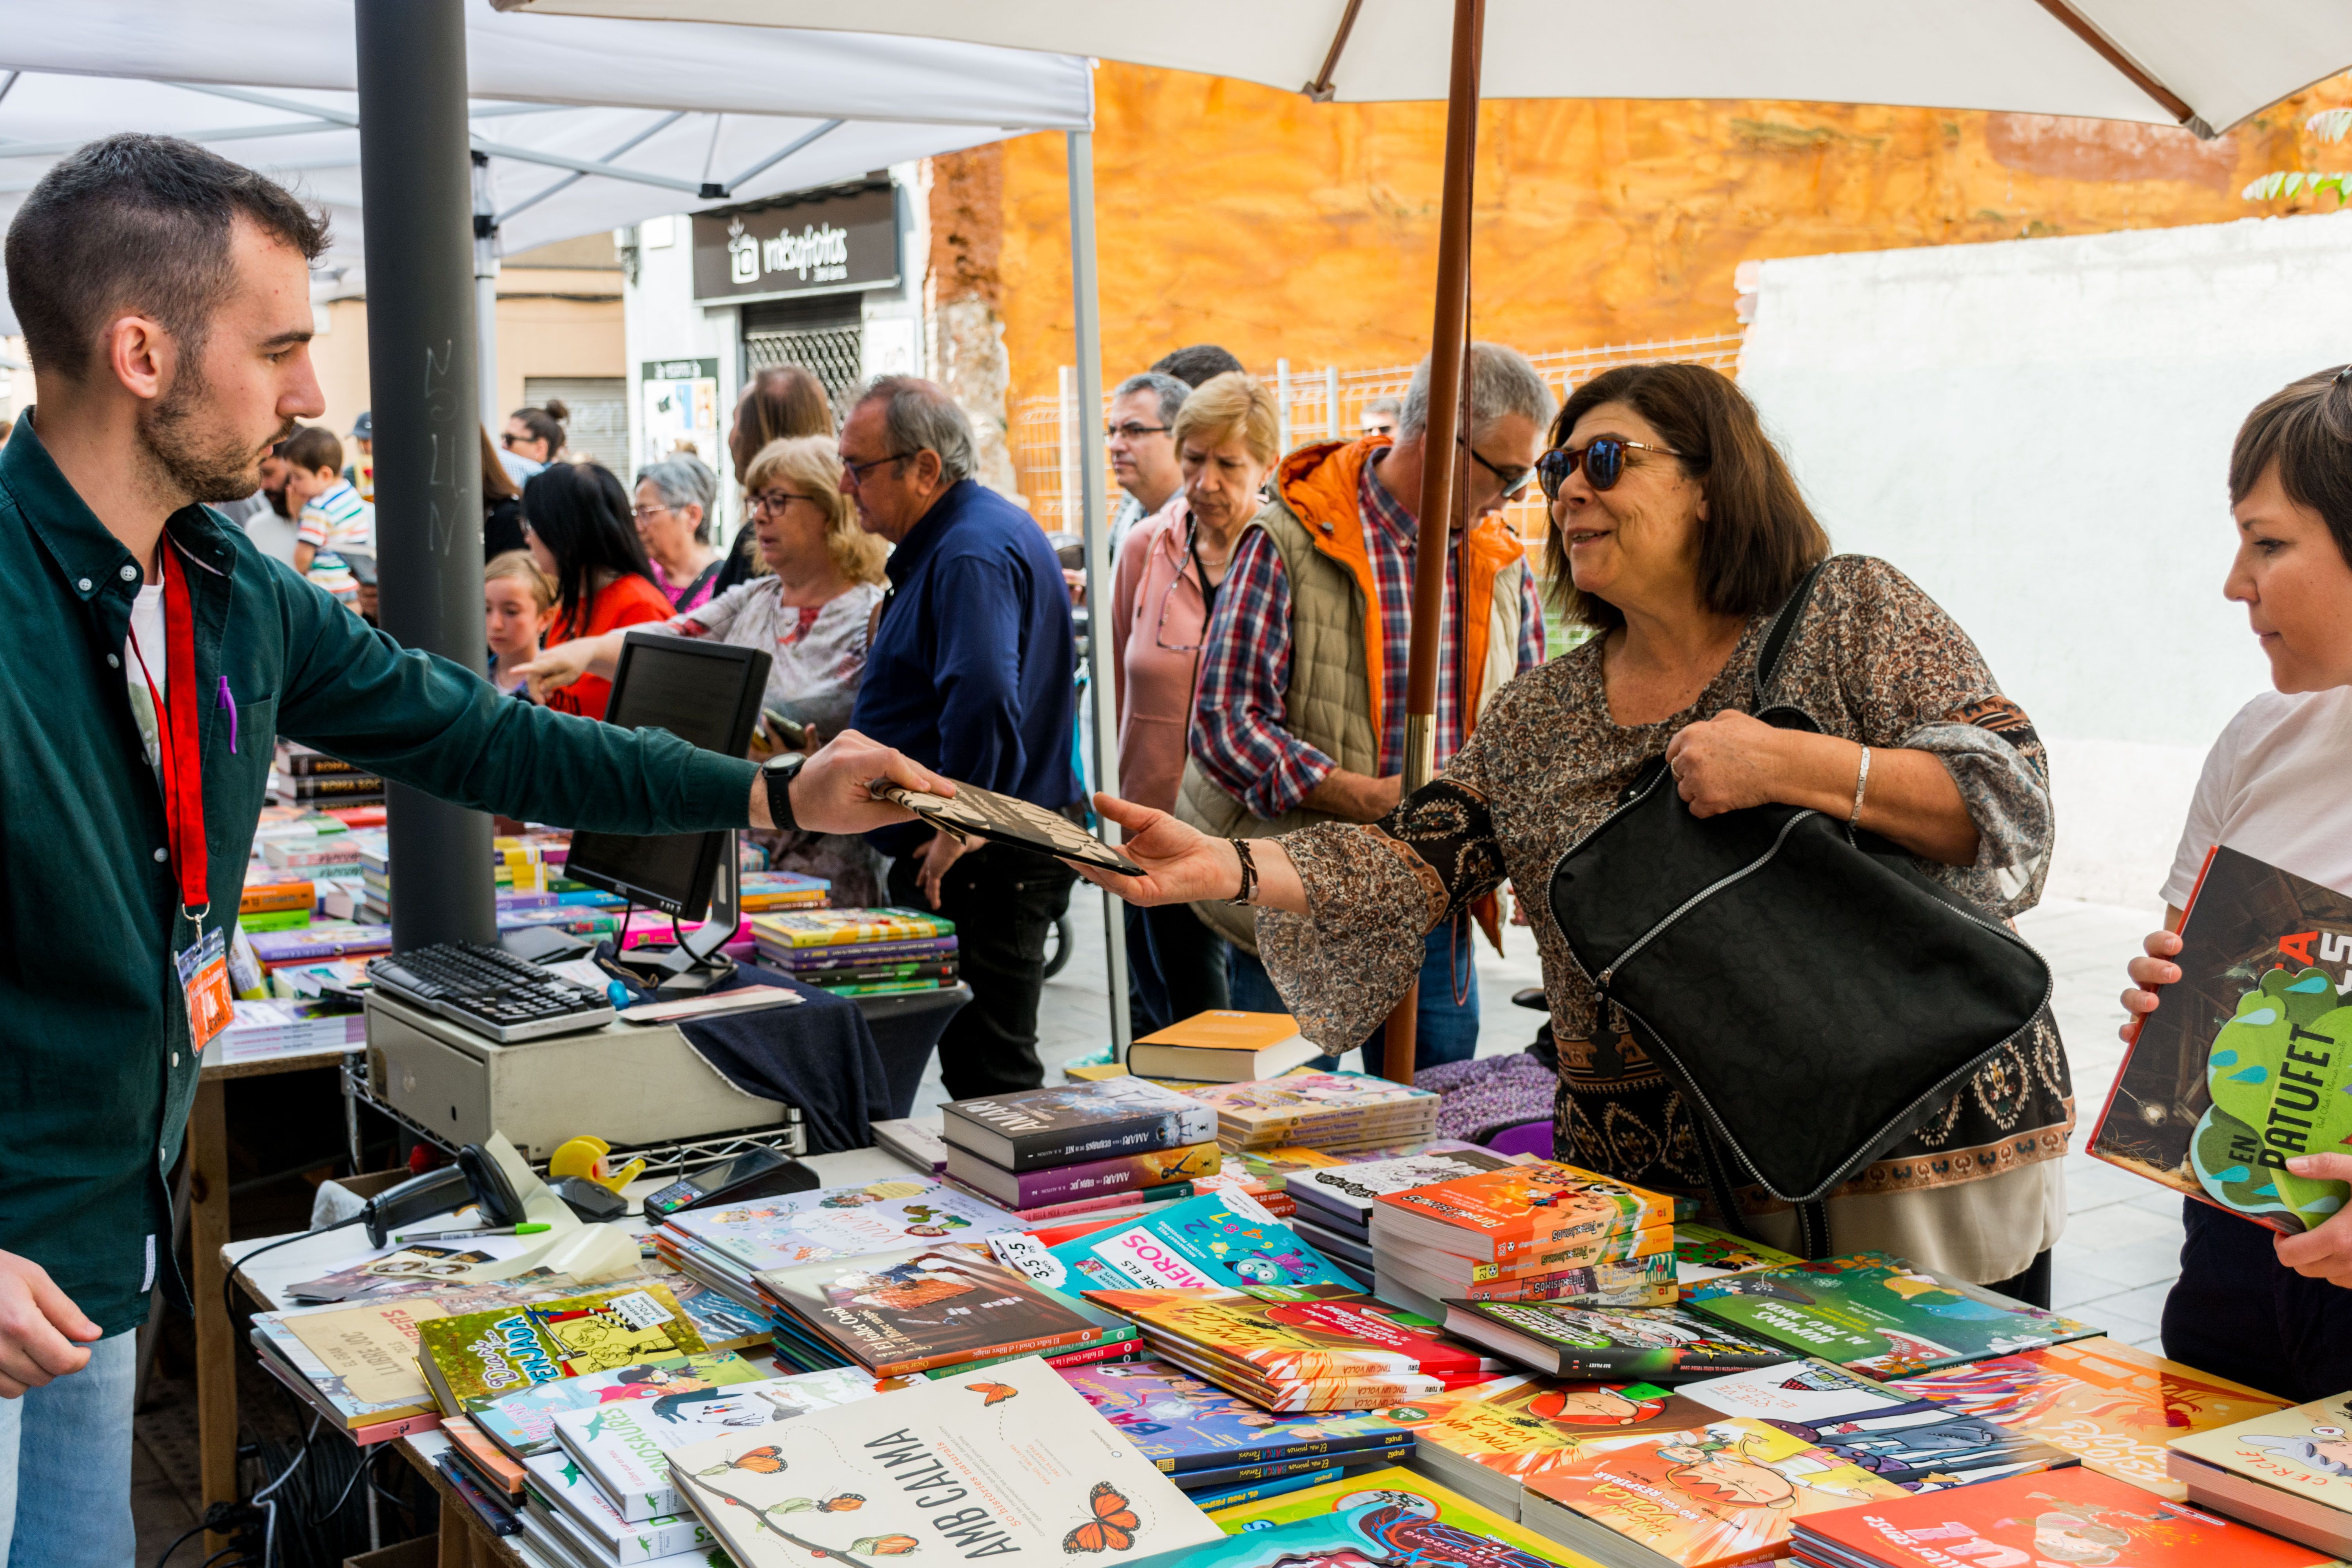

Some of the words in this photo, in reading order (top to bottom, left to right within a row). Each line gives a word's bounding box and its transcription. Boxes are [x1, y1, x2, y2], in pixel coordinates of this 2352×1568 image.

[321, 780, 355, 792] ROMA
[2229, 1134, 2258, 1164] EN
[2257, 1023, 2335, 1171] PATUFET
[958, 1100, 1049, 1131] AMARI
[2316, 1116, 2325, 1129] Bel
[1123, 1132, 1149, 1145] AMARI
[1103, 1171, 1130, 1185] AMARI
[1498, 1242, 1506, 1256] 21
[1022, 1259, 1050, 1279] 3-5
[1041, 1259, 1056, 1273] ANYS
[1121, 1260, 1138, 1274] ELS
[1480, 1266, 1487, 1279] 21
[1534, 1276, 1586, 1297] FUTBOLÍSIMOS
[619, 1299, 640, 1316] estrella
[634, 1304, 654, 1318] POC
[638, 1296, 668, 1318] glamurosa
[1755, 1301, 1809, 1321] JARDÍ
[639, 1315, 649, 1326] Una
[822, 1306, 859, 1325] Oriol
[852, 1323, 884, 1342] follet
[1751, 1311, 1835, 1344] HUMANS
[1805, 1320, 1848, 1338] MEU
[339, 1331, 372, 1351] JOC
[870, 1341, 896, 1350] El
[1037, 1338, 1054, 1347] follet
[1845, 1336, 1871, 1345] AL
[973, 1348, 991, 1357] màgic
[992, 1345, 1008, 1354] llibre
[1081, 1351, 1097, 1360] follet
[357, 1347, 404, 1377] LLIBRE
[470, 1339, 520, 1388] Diari
[1343, 1365, 1364, 1374] VOLCÀ
[1358, 1386, 1380, 1395] VOLCÀ
[1715, 1384, 1739, 1395] VE
[1354, 1399, 1377, 1407] VOLCÀ
[1740, 1394, 1770, 1409] QUE
[1776, 1399, 1799, 1410] EL
[1439, 1417, 1469, 1432] UN
[1473, 1414, 1531, 1439] VOLCÀ
[1385, 1436, 1403, 1445] grup62
[1469, 1428, 1519, 1452] TINC
[608, 1450, 620, 1459] mou
[1009, 1444, 1030, 1465] WILLIAMS
[1026, 1444, 1044, 1462] HARTAS
[1262, 1447, 1288, 1459] BARÇA
[1290, 1446, 1308, 1457] primer
[1308, 1445, 1320, 1454] meu
[1320, 1443, 1328, 1453] El
[1387, 1449, 1405, 1459] grup62
[936, 1441, 972, 1477] naturals
[1239, 1450, 1261, 1462] Femení
[1321, 1458, 1330, 1468] El
[864, 1428, 968, 1508] CALMA
[1044, 1462, 1061, 1477] FREYA
[1240, 1465, 1262, 1477] Femení
[1262, 1463, 1288, 1475] BARÇA
[1289, 1462, 1309, 1472] primer
[1309, 1460, 1321, 1469] meu
[2235, 1449, 2328, 1485] CERCLE
[628, 1472, 641, 1482] llibre
[1031, 1465, 1051, 1485] RACHEL
[1314, 1472, 1332, 1483] grup62
[1593, 1471, 1665, 1497] RESPIRAR
[590, 1495, 604, 1504] mou
[970, 1476, 1009, 1516] històries
[1587, 1483, 1679, 1523] VOLCÀ
[1654, 1496, 1682, 1511] VULL
[1005, 1515, 1022, 1528] 50
[1677, 1509, 1700, 1520] NO
[933, 1506, 1022, 1559] AMB
[1862, 1515, 1918, 1546] sense
[1403, 1530, 1494, 1567] ARMSTRONG
[1742, 1555, 1758, 1564] Tirado
[1759, 1552, 1775, 1561] Miriam
